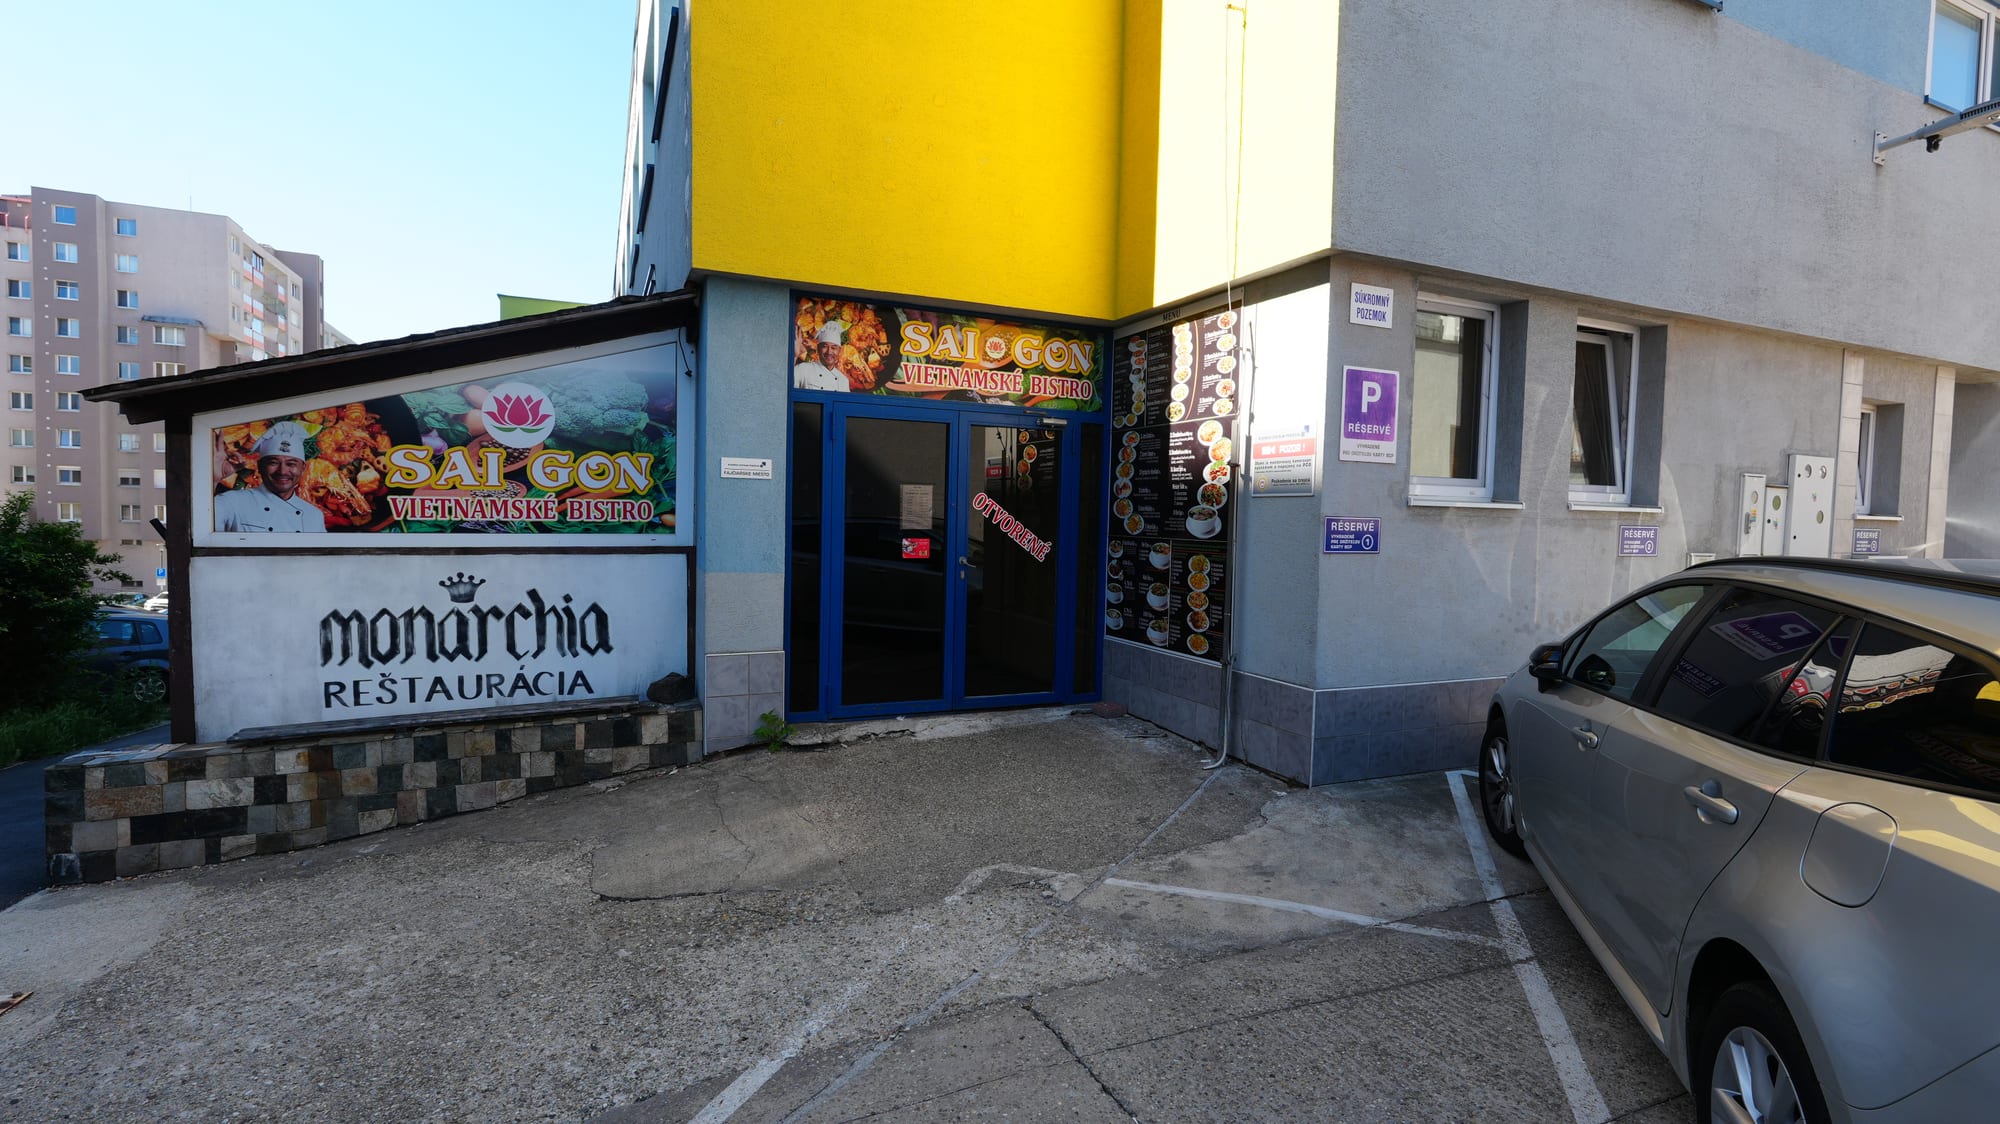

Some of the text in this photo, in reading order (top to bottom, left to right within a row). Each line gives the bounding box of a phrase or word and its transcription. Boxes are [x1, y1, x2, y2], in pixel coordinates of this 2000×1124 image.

[1354, 289, 1390, 307] SÚKROMNÝ
[1356, 307, 1387, 322] POZEMOK
[900, 321, 1094, 375] SAI GON
[901, 362, 1093, 400] VIETNAMSKÉ BISTRO
[1361, 381, 1382, 413] P
[1348, 421, 1392, 435] RÉSERVÉ
[385, 444, 655, 494] SAI GON
[388, 493, 653, 522] VIETNAMSKÉ BISTRO
[973, 491, 1053, 562] OTVORENÉ
[1331, 520, 1375, 532] RÉSERVÉ
[1624, 529, 1655, 538] RÉSERVÉ
[1365, 538, 1370, 546] 1
[319, 588, 614, 669] monarchia
[324, 665, 595, 709] REŠTAURÁCIA
